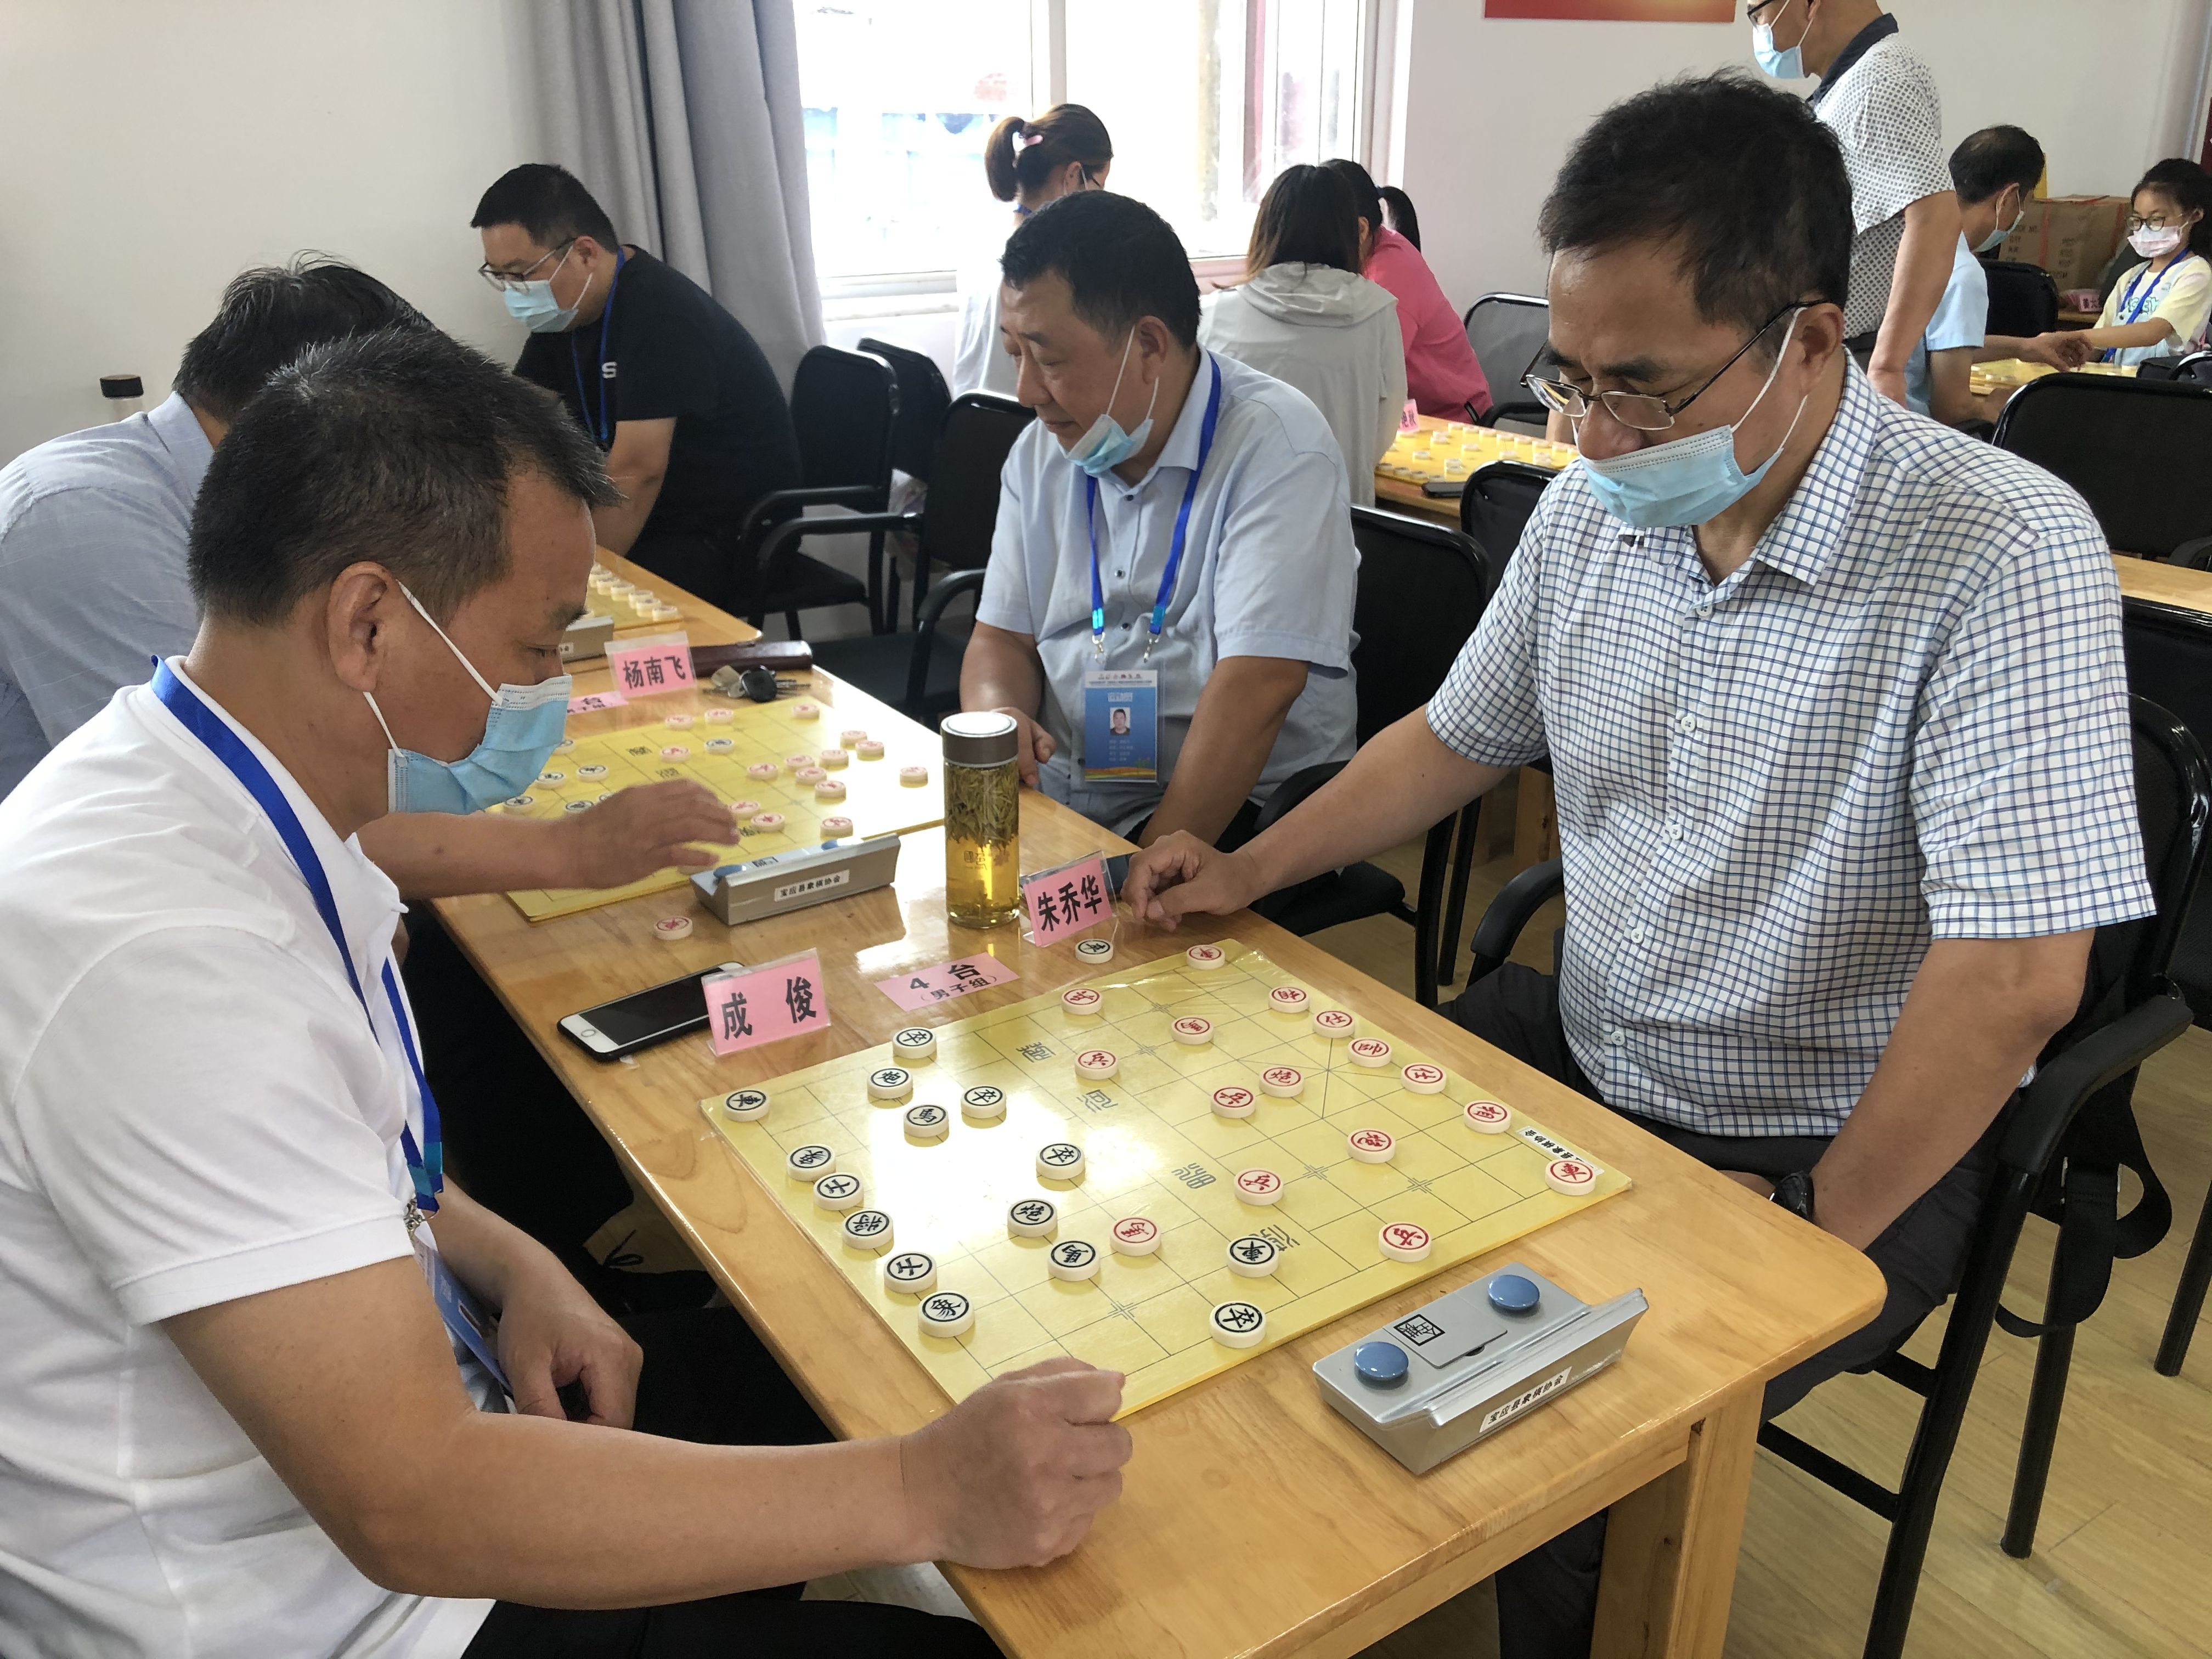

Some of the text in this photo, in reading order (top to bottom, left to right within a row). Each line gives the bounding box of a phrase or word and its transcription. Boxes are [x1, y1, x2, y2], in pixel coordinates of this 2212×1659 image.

[623, 656, 686, 690] 杨南飞
[1037, 874, 1103, 932] 朱乔华
[721, 976, 816, 1040] 成俊
[1326, 1013, 1345, 1024] 仕
[903, 1031, 927, 1043] 卒
[1084, 1053, 1108, 1065] 兵
[878, 1071, 901, 1084] 炮
[1269, 1070, 1293, 1083] 炮
[1411, 1068, 1436, 1080] 仕
[733, 1094, 761, 1107] 車
[972, 1090, 996, 1103] 卒
[1220, 1090, 1247, 1104] 兵
[913, 1109, 937, 1122] 馬
[1474, 1107, 1502, 1118] 相
[1358, 1132, 1386, 1147] 炮
[1047, 1147, 1074, 1163] 卒
[1525, 1129, 1594, 1169] 县象棋协会
[1560, 1163, 1587, 1180] 車
[825, 1179, 850, 1194] 士
[1244, 1175, 1276, 1190] 兵
[1016, 1204, 1044, 1221] 炮
[1121, 1222, 1149, 1238] 馬
[1394, 1228, 1422, 1246] 兵
[1062, 1245, 1088, 1263] 馬
[1237, 1241, 1266, 1261] 車
[896, 1257, 923, 1276] 士
[931, 1299, 961, 1317] 象
[1222, 1308, 1254, 1328] 卒
[1488, 1374, 1564, 1425] 宝应县象棋协会
